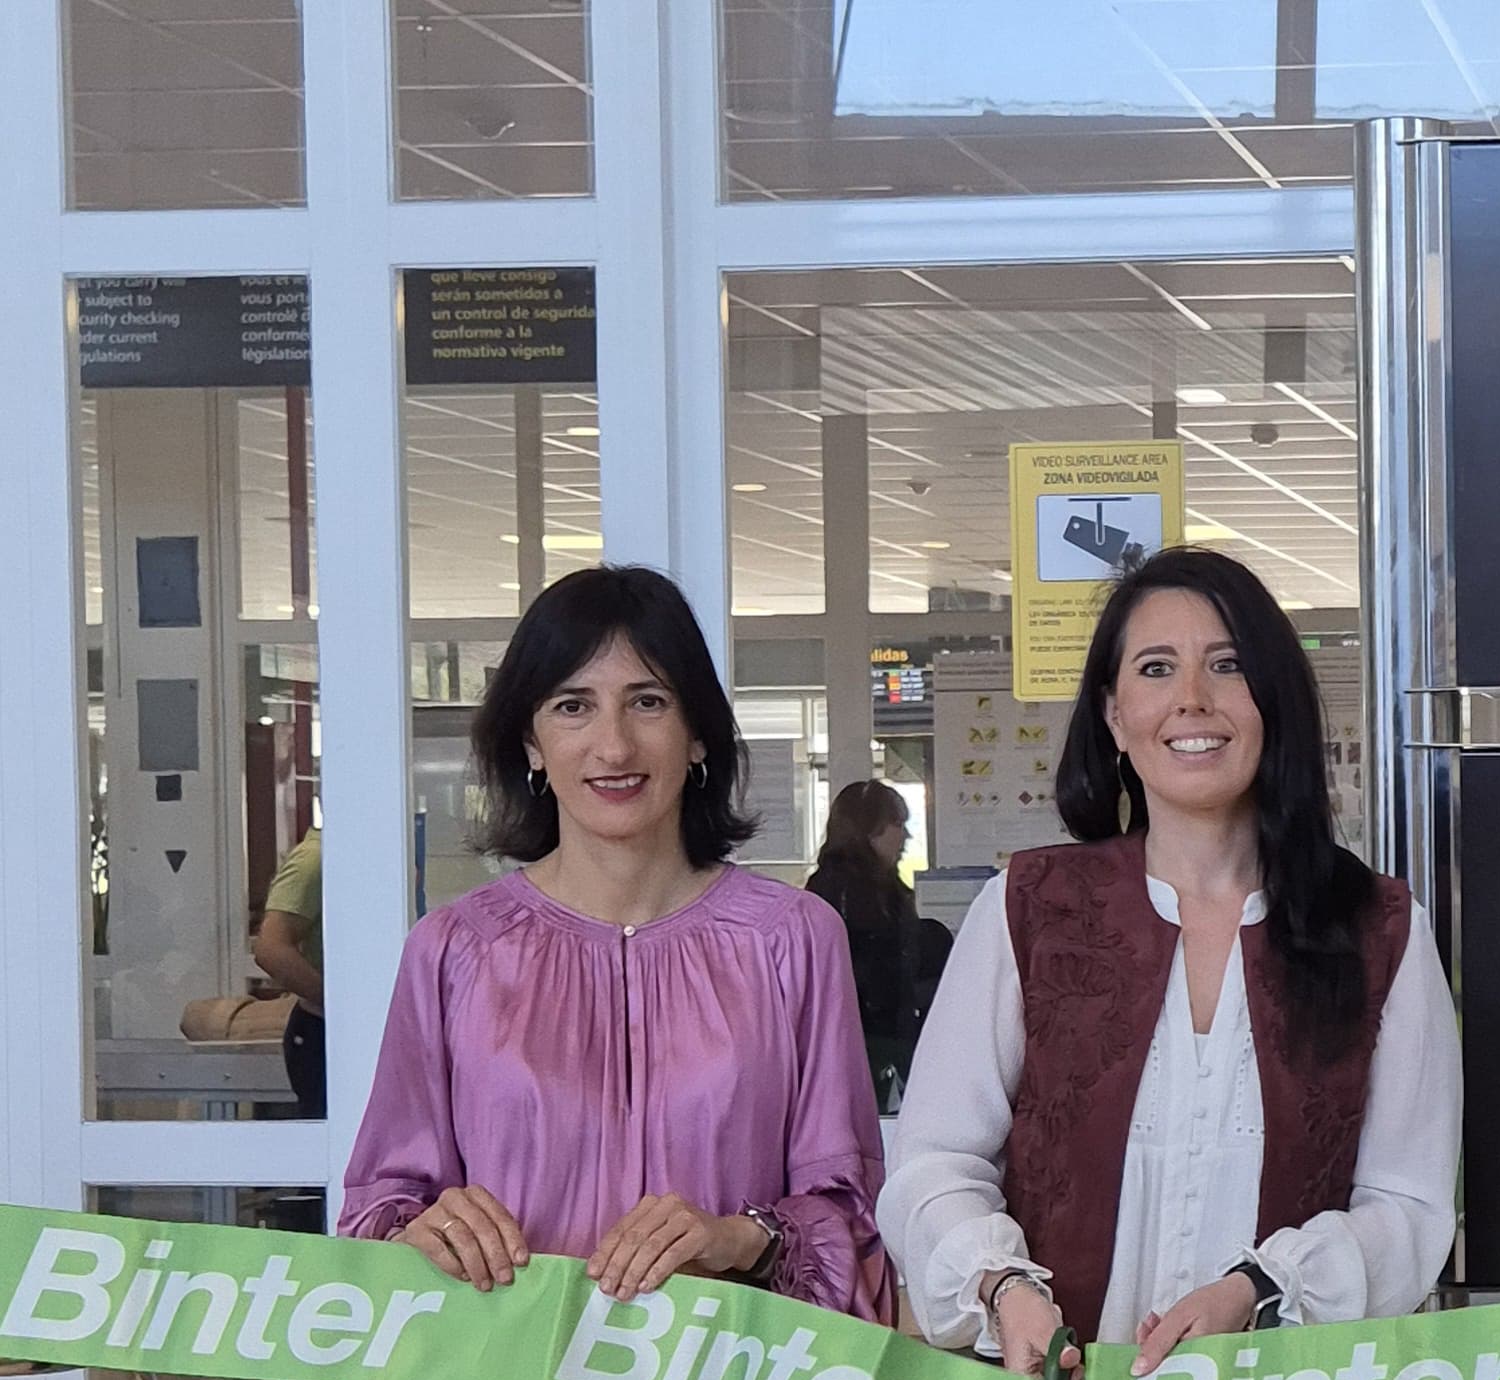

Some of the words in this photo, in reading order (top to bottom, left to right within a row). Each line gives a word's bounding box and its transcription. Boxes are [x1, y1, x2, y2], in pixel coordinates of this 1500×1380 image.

[431, 271, 458, 285] que
[501, 269, 557, 284] consigo
[85, 293, 133, 309] subject
[138, 294, 153, 306] to
[241, 293, 272, 305] vous
[431, 288, 471, 302] serán
[475, 286, 549, 301] sometidos
[554, 289, 563, 300] a
[120, 311, 180, 329] checking
[432, 310, 451, 321] un
[455, 306, 508, 321] control
[511, 305, 530, 319] de
[108, 330, 159, 344] current
[432, 325, 503, 340] conforme
[506, 327, 516, 339] a
[520, 324, 533, 338] la
[433, 343, 508, 359] normativa
[512, 343, 566, 360] vigente
[1032, 455, 1063, 468] VIDEO
[1064, 453, 1138, 467] SURVEILLANCE
[1141, 453, 1168, 465] AREA
[1044, 472, 1074, 485] ZONA
[1076, 470, 1159, 484] VIDEOVIGILADA
[0, 1226, 446, 1368] Binter
